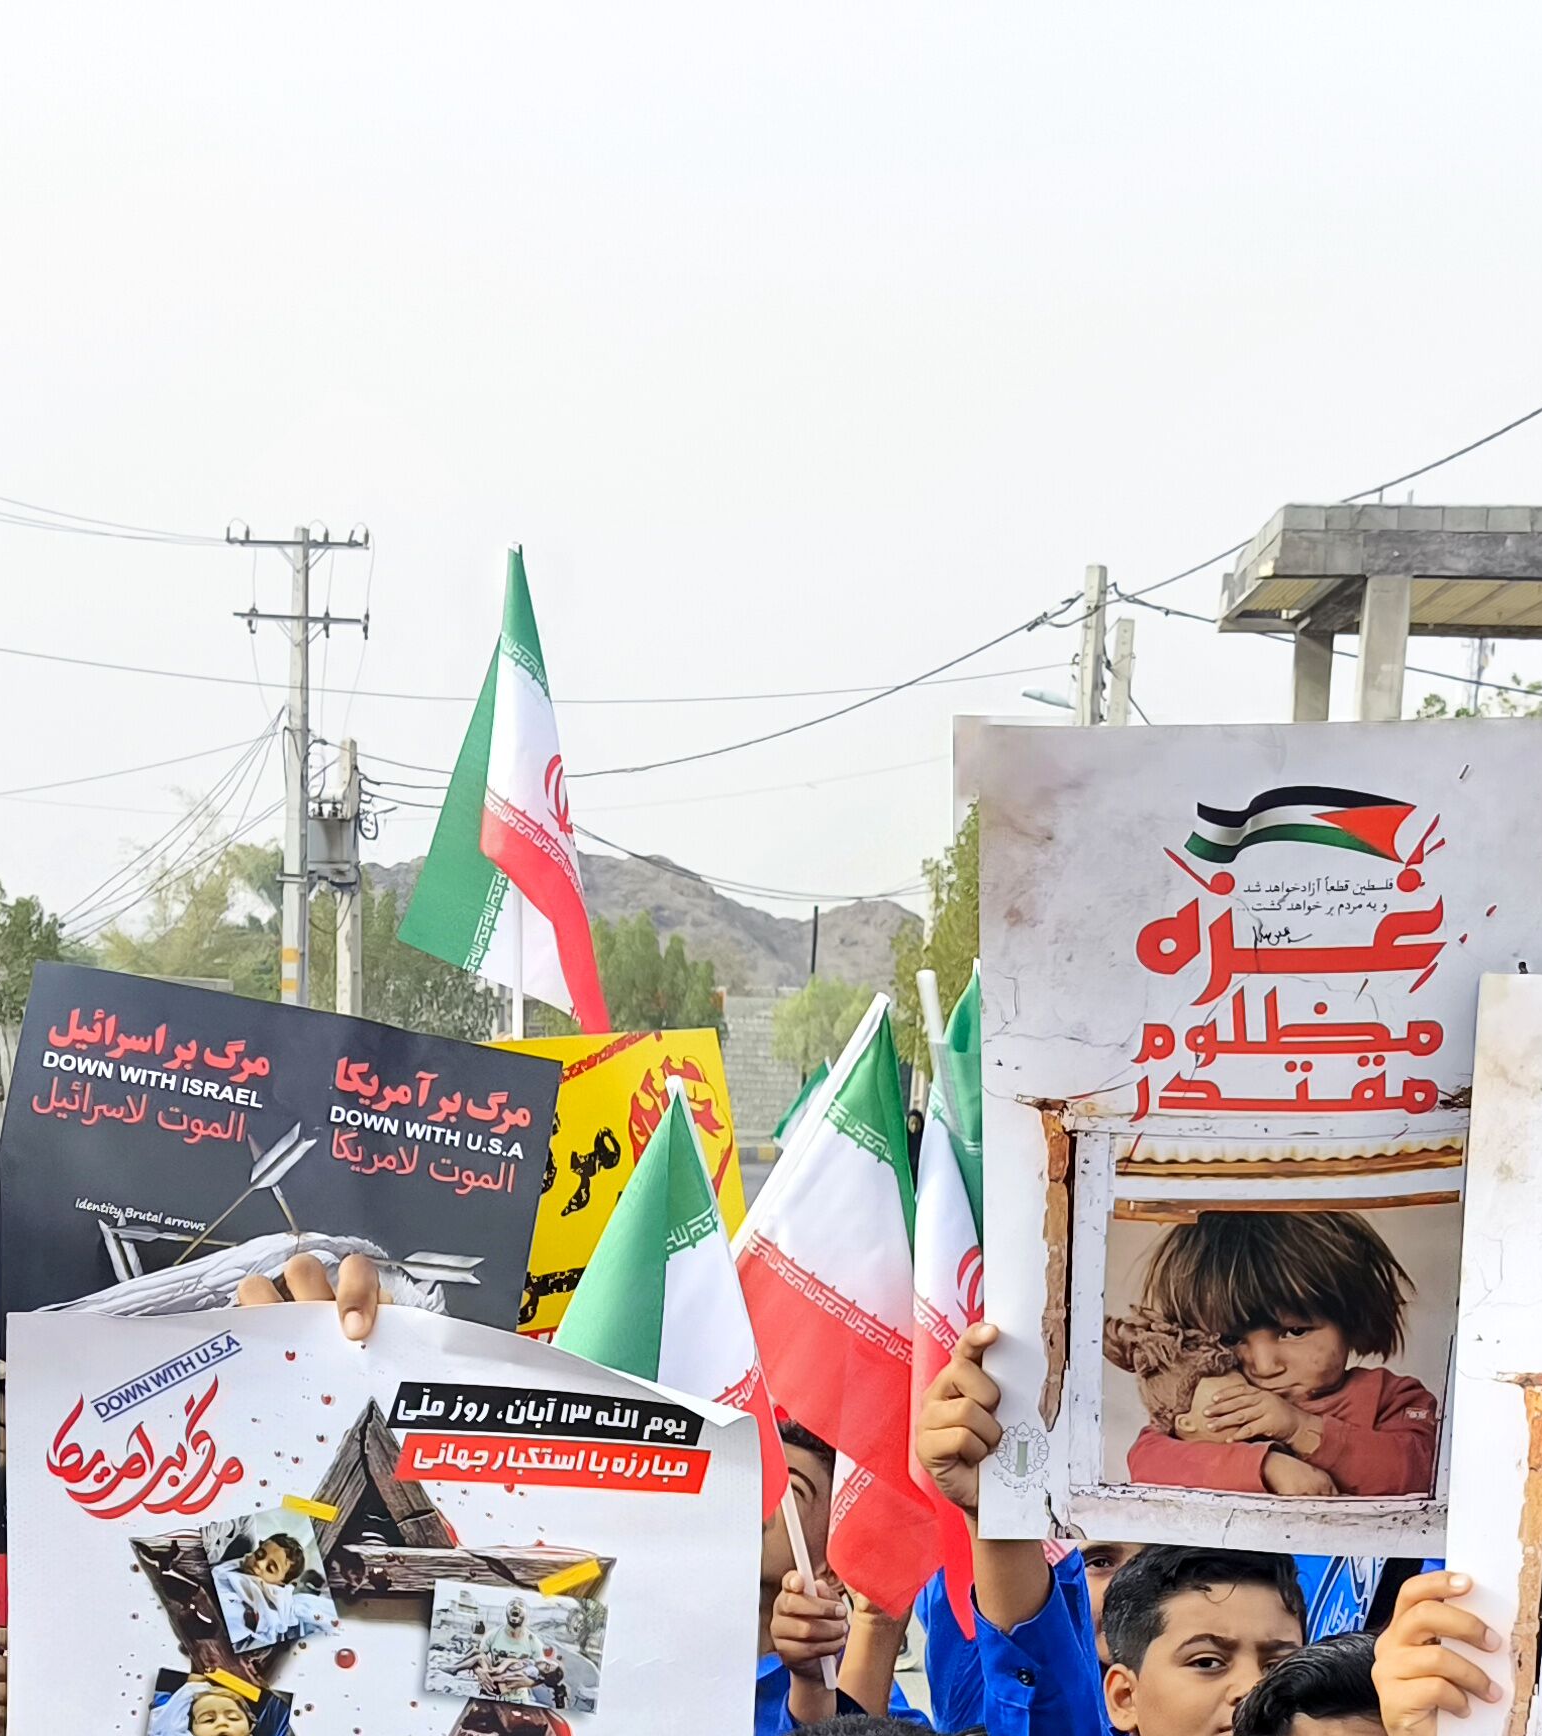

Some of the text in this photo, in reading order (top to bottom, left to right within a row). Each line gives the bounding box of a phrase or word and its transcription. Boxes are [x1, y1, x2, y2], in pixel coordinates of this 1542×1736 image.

[1243, 880, 1262, 894] شد
[1265, 881, 1298, 899] خواهد
[1300, 877, 1322, 897] آزاد
[1352, 877, 1394, 896] فلسطین
[1286, 900, 1388, 916] و به مردم خواهد
[1135, 862, 1447, 1007] غزه
[1131, 985, 1445, 1064] مظلوم
[48, 1007, 271, 1083] مرگ بر اسرائیل
[42, 1050, 264, 1109] DOWN WITH ISRAEL
[334, 1056, 532, 1135] مرگ بر آمریکا
[1131, 1055, 1440, 1123] مقتدر
[157, 1105, 247, 1145] الموت
[329, 1104, 525, 1161] DOWN WITH U.S.A
[427, 1156, 517, 1197] الموت
[74, 1197, 207, 1232] Identity Brutal arrows
[93, 1334, 241, 1419] DOWN WITH U.S.A
[448, 1394, 490, 1423] روز
[560, 1403, 592, 1424] ۱۳
[594, 1401, 639, 1429] الله
[642, 1417, 688, 1441] یوم
[413, 1442, 689, 1484] مبارزه با استکبار جهانی
